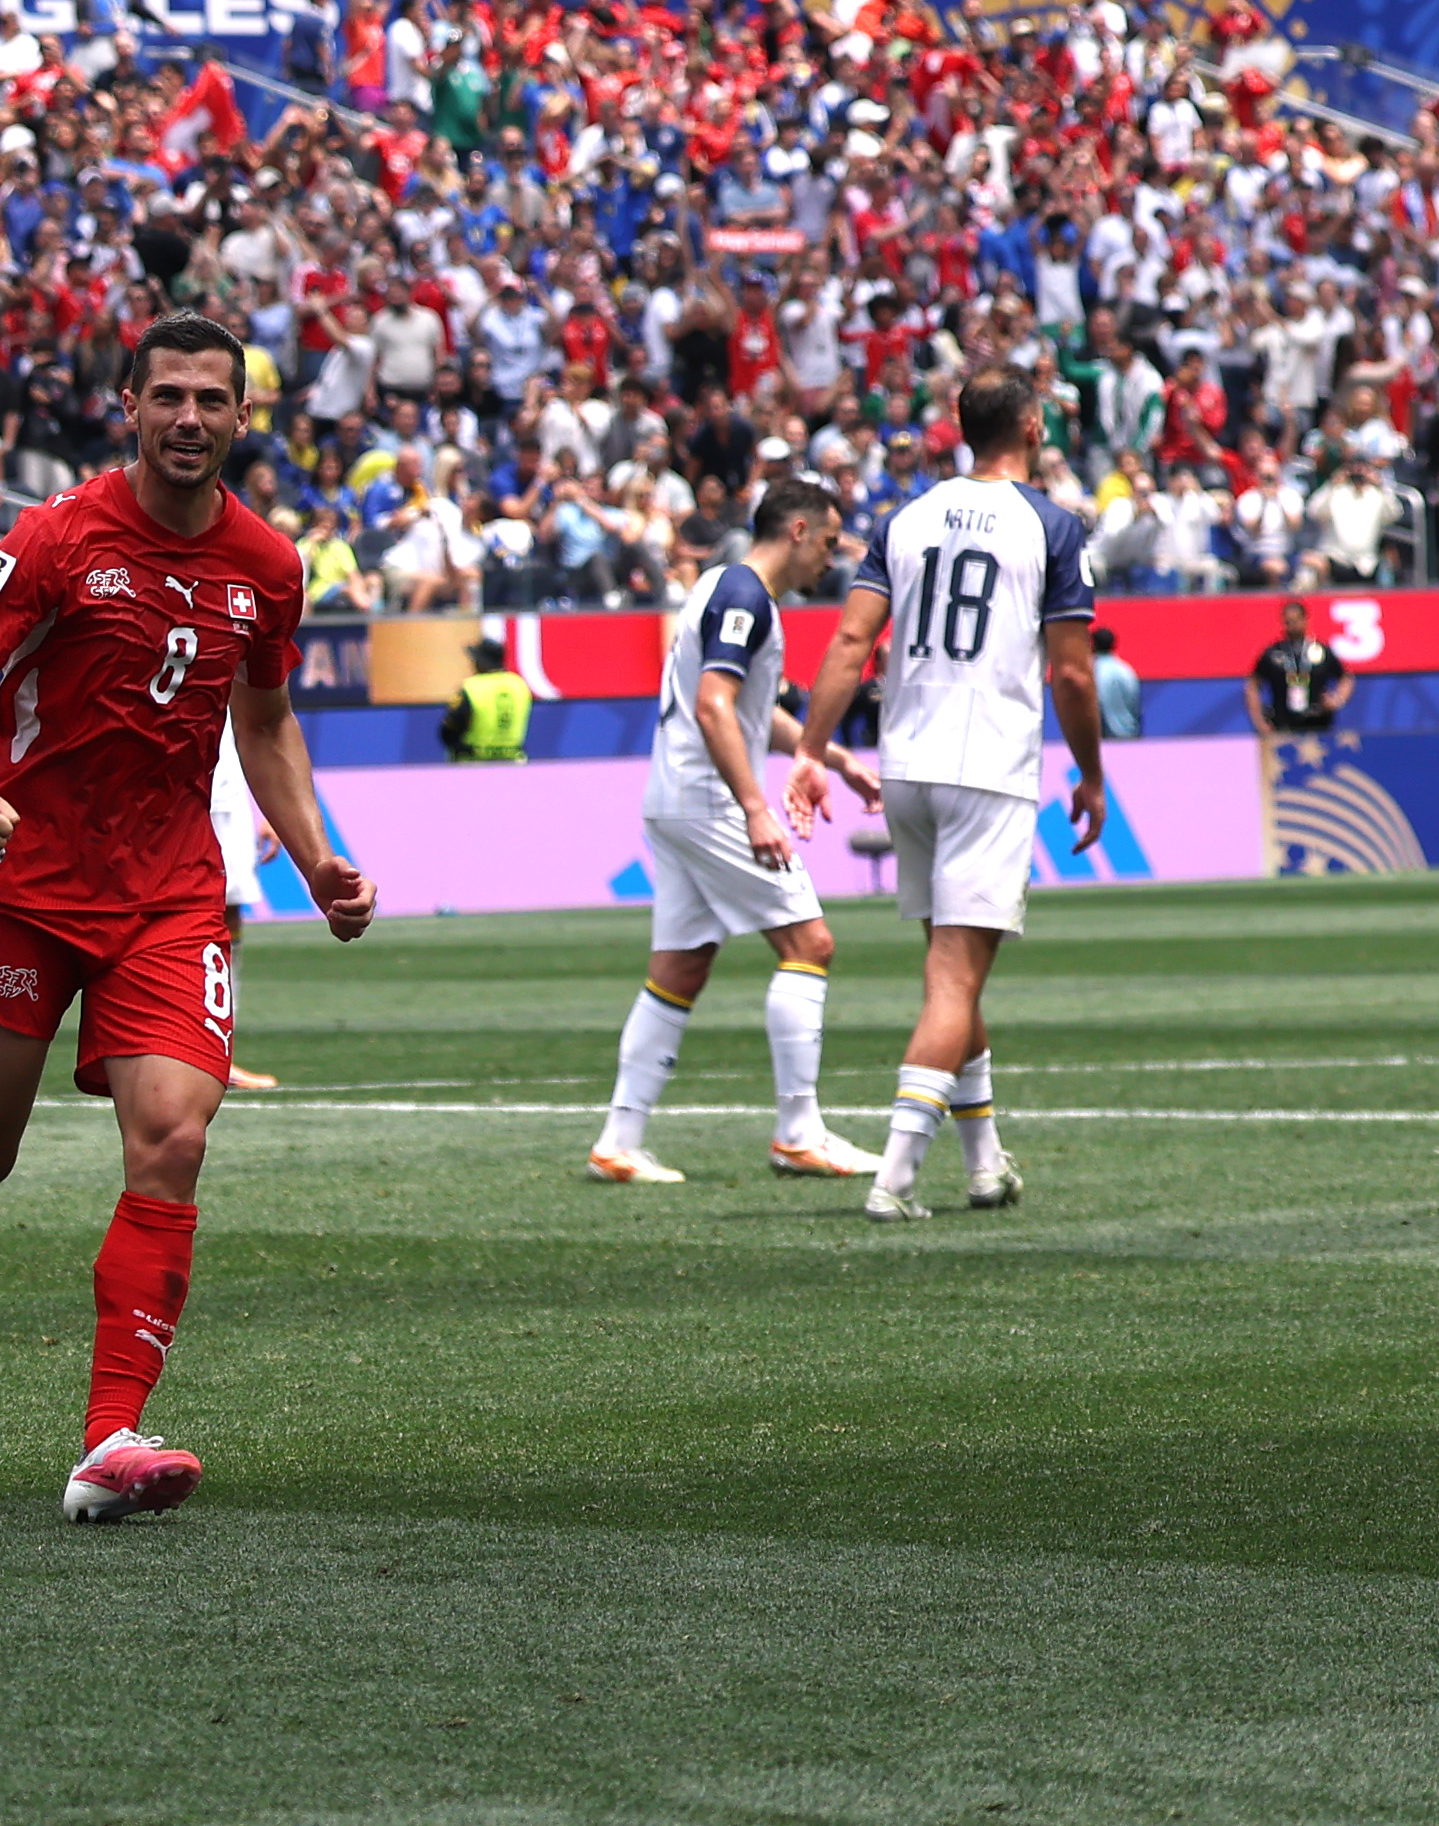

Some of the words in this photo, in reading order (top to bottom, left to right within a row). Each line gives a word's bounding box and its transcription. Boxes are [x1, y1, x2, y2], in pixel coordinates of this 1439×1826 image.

[909, 546, 1001, 663] 18
[1327, 600, 1385, 665] 3
[148, 627, 198, 705] 8
[201, 943, 231, 1021] 8
